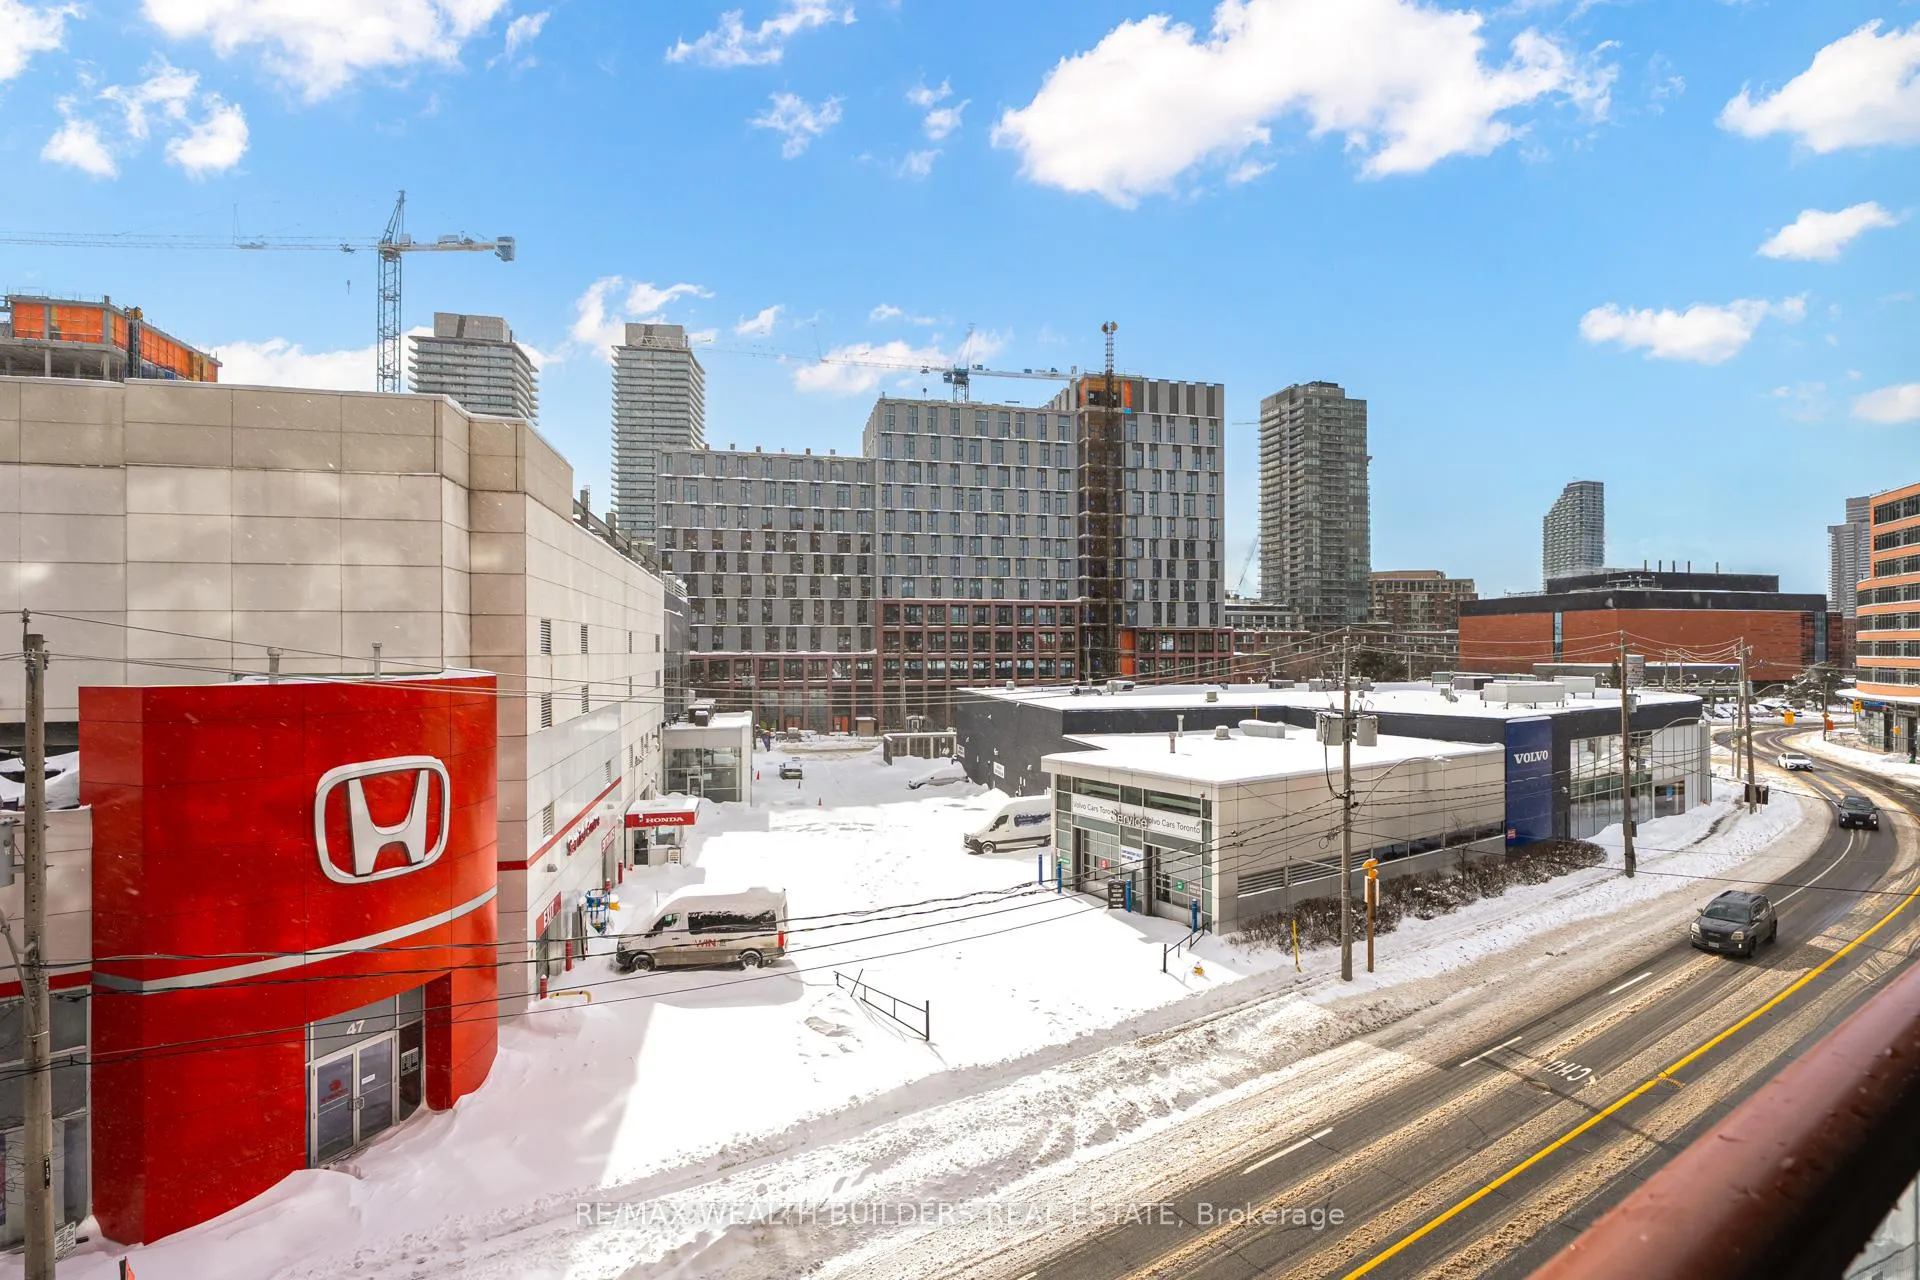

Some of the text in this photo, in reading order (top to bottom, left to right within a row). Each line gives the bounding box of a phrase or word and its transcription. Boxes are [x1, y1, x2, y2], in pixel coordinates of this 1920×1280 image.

[1513, 750, 1549, 764] VOLVO
[1087, 804, 1099, 813] Cars
[1161, 819, 1175, 829] Cars
[1176, 822, 1201, 834] Toronto
[543, 901, 555, 928] EXIT
[346, 1019, 366, 1035] 47
